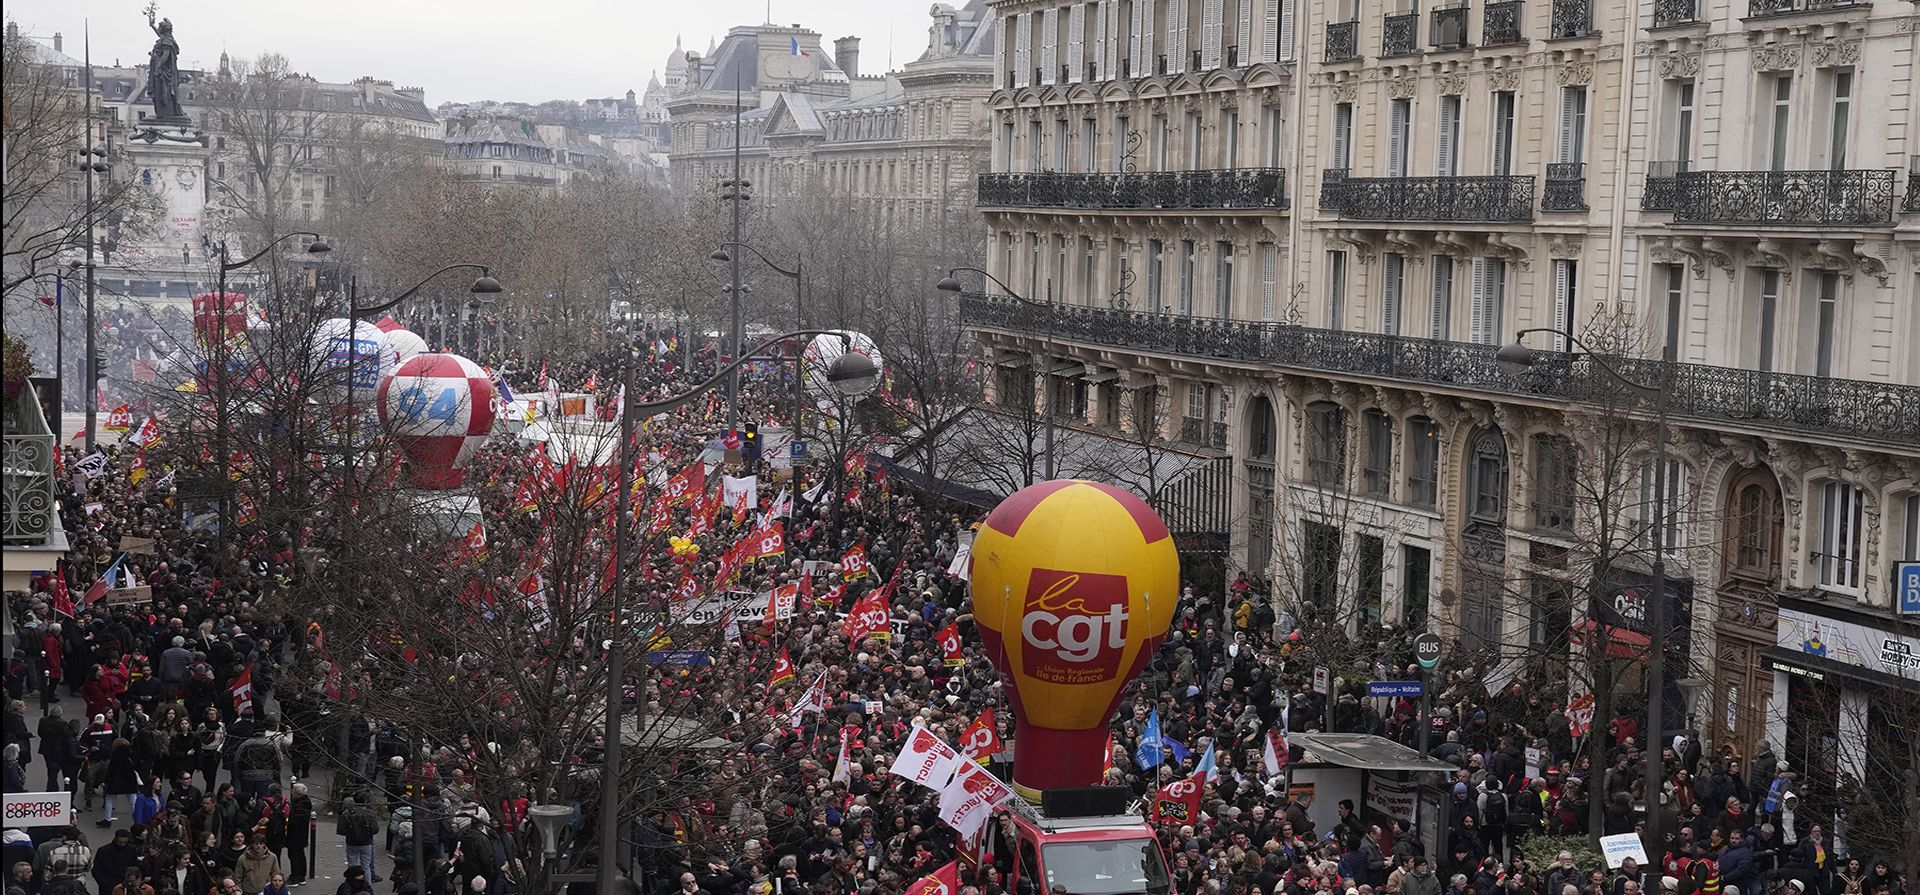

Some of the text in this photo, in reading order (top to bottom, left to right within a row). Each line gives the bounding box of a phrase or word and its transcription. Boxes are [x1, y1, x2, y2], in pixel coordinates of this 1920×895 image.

[399, 387, 456, 426] 94
[794, 444, 803, 455] P
[1908, 574, 1920, 588] B
[1027, 574, 1114, 614] la
[1907, 589, 1920, 603] D
[1745, 605, 1751, 615] 5
[1022, 603, 1129, 662] cgt
[1420, 642, 1438, 653] BUS
[1881, 651, 1909, 667] HOBBY
[1370, 685, 1397, 694] République
[1402, 685, 1421, 693] Voltaire
[1432, 717, 1443, 726] 56
[6, 801, 62, 812] COPYTOP
[6, 809, 62, 819] COPYTOP
